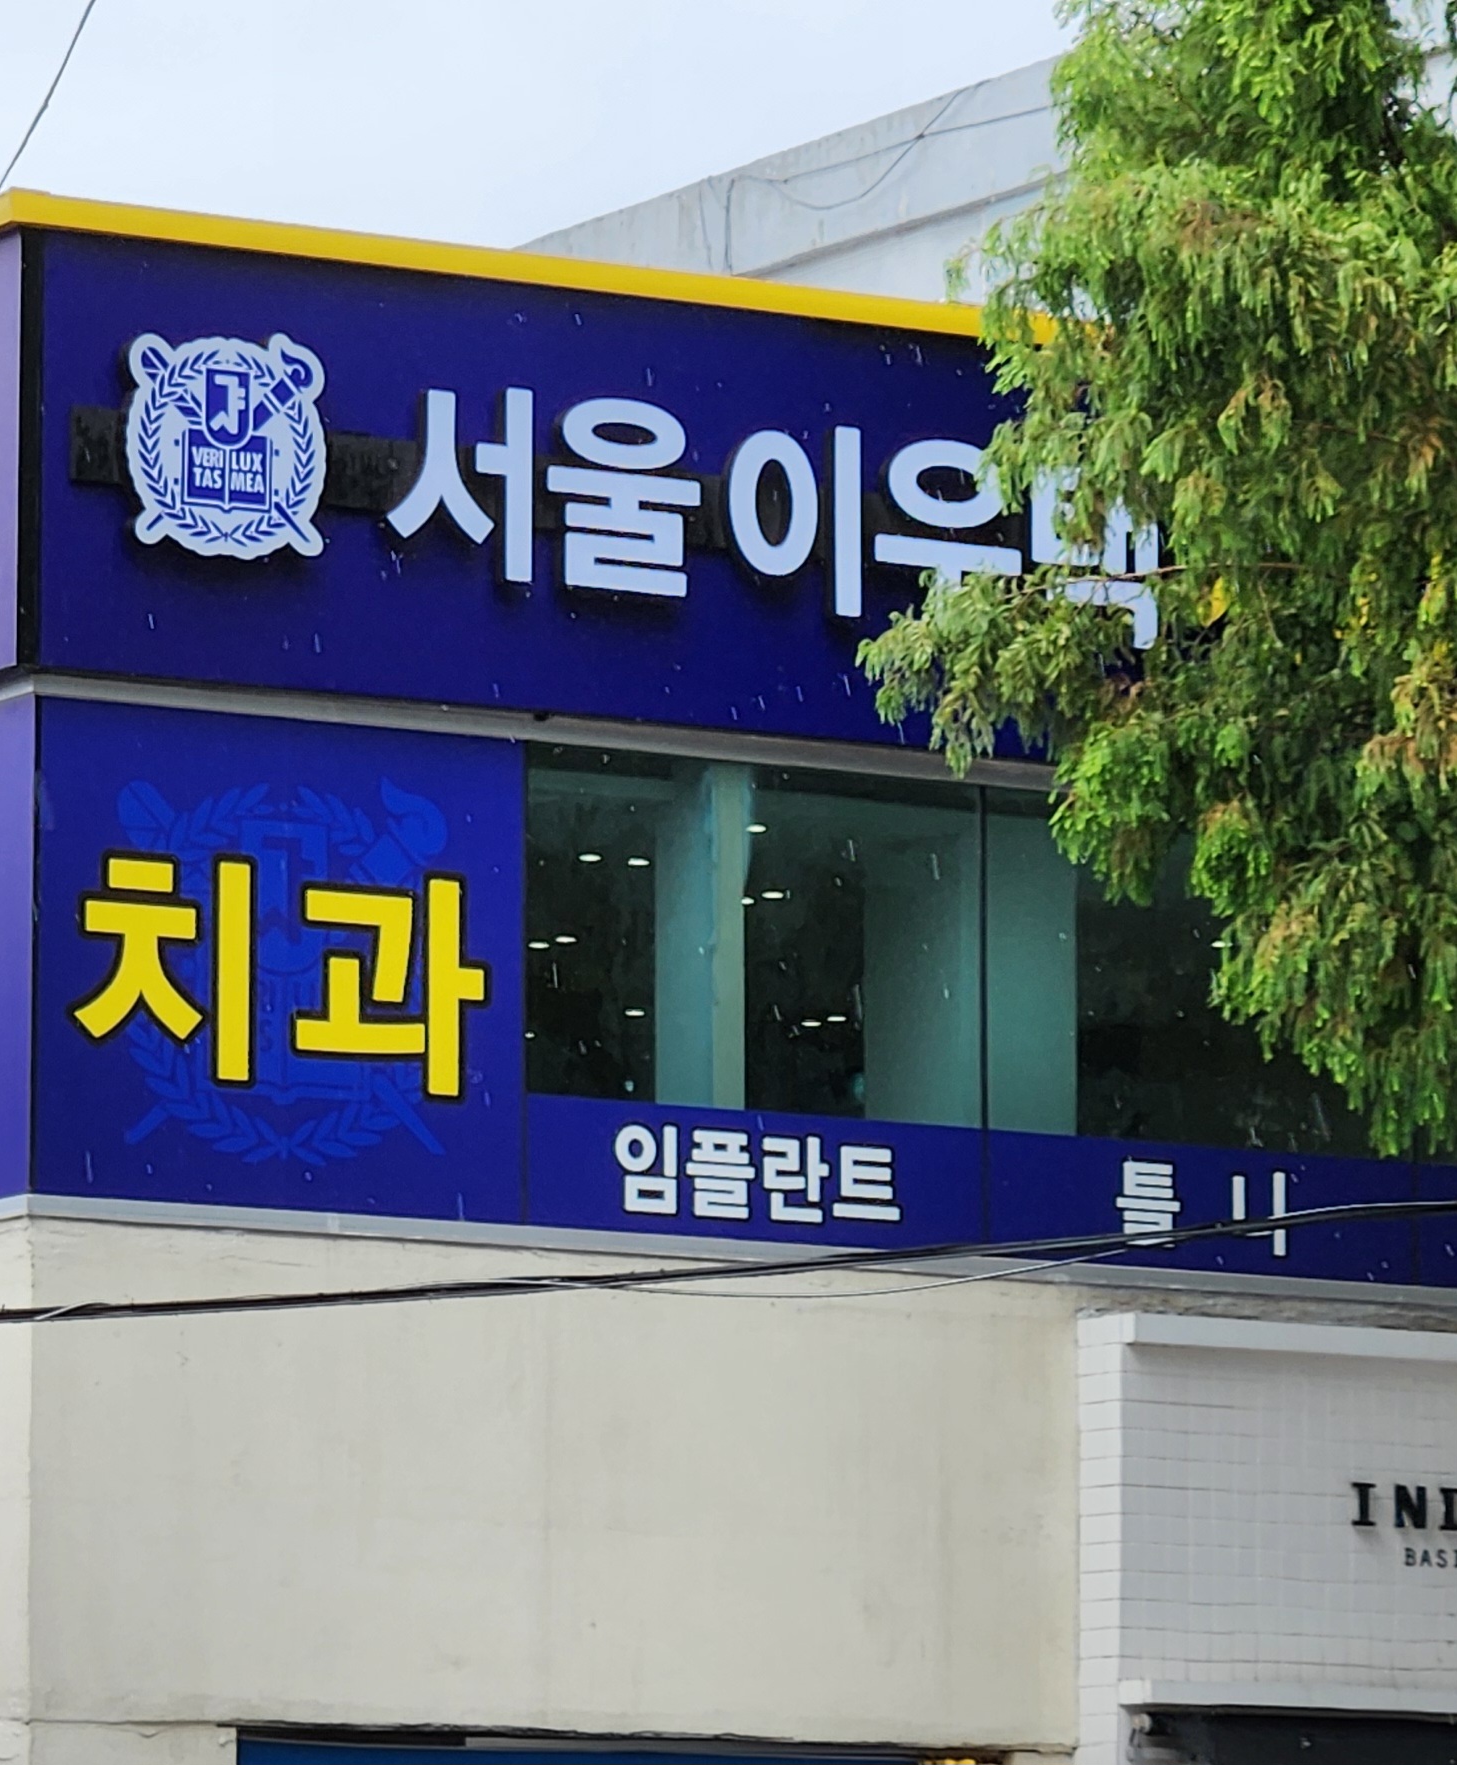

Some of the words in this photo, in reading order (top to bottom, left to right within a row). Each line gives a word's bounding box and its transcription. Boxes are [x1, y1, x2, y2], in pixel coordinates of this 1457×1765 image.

[191, 446, 223, 468] VERI
[232, 451, 263, 473] LUX
[194, 467, 222, 489] TAS
[231, 473, 264, 494] MEA
[73, 857, 485, 1097] 치과
[614, 1122, 901, 1225] 임플란트
